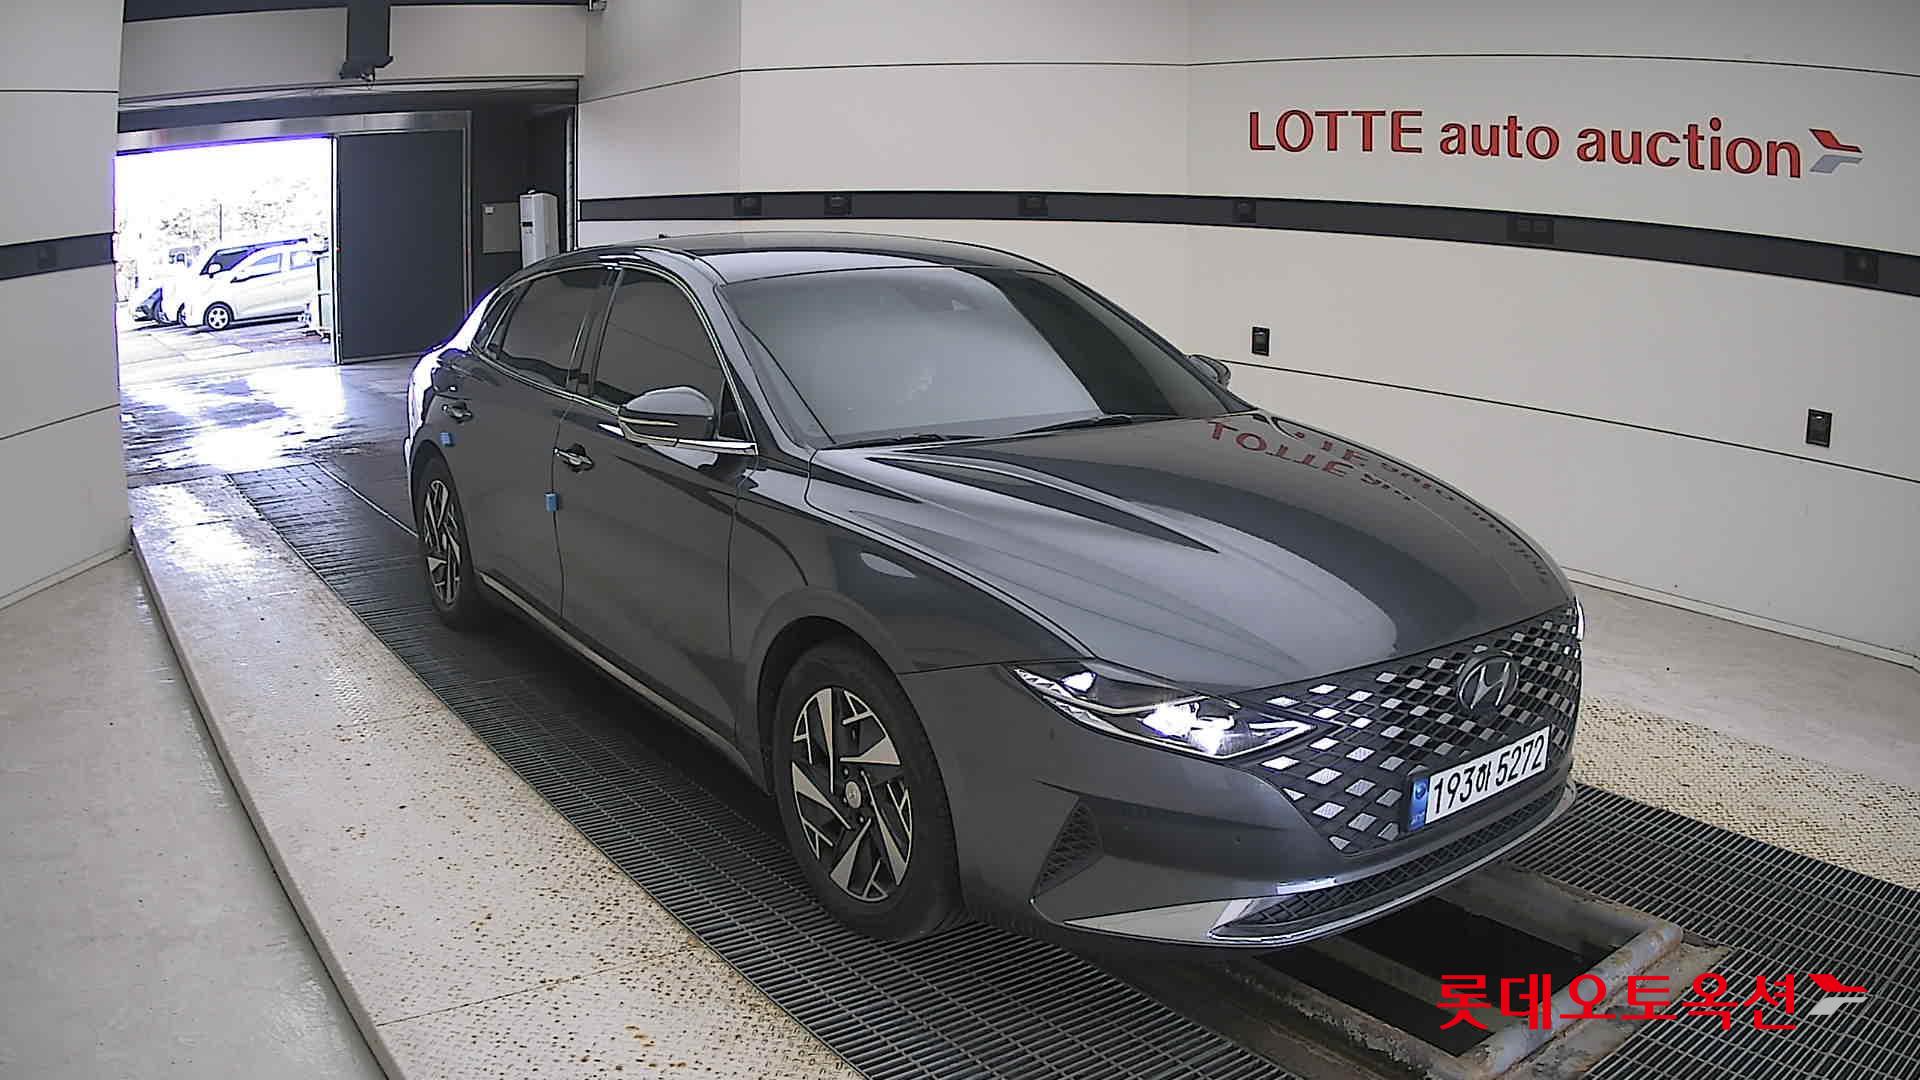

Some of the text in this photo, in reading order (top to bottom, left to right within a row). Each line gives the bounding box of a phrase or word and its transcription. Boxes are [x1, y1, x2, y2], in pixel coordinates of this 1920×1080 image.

[1249, 110, 1801, 179] LOTTE auto auction
[1434, 734, 1545, 814] 193하 5272
